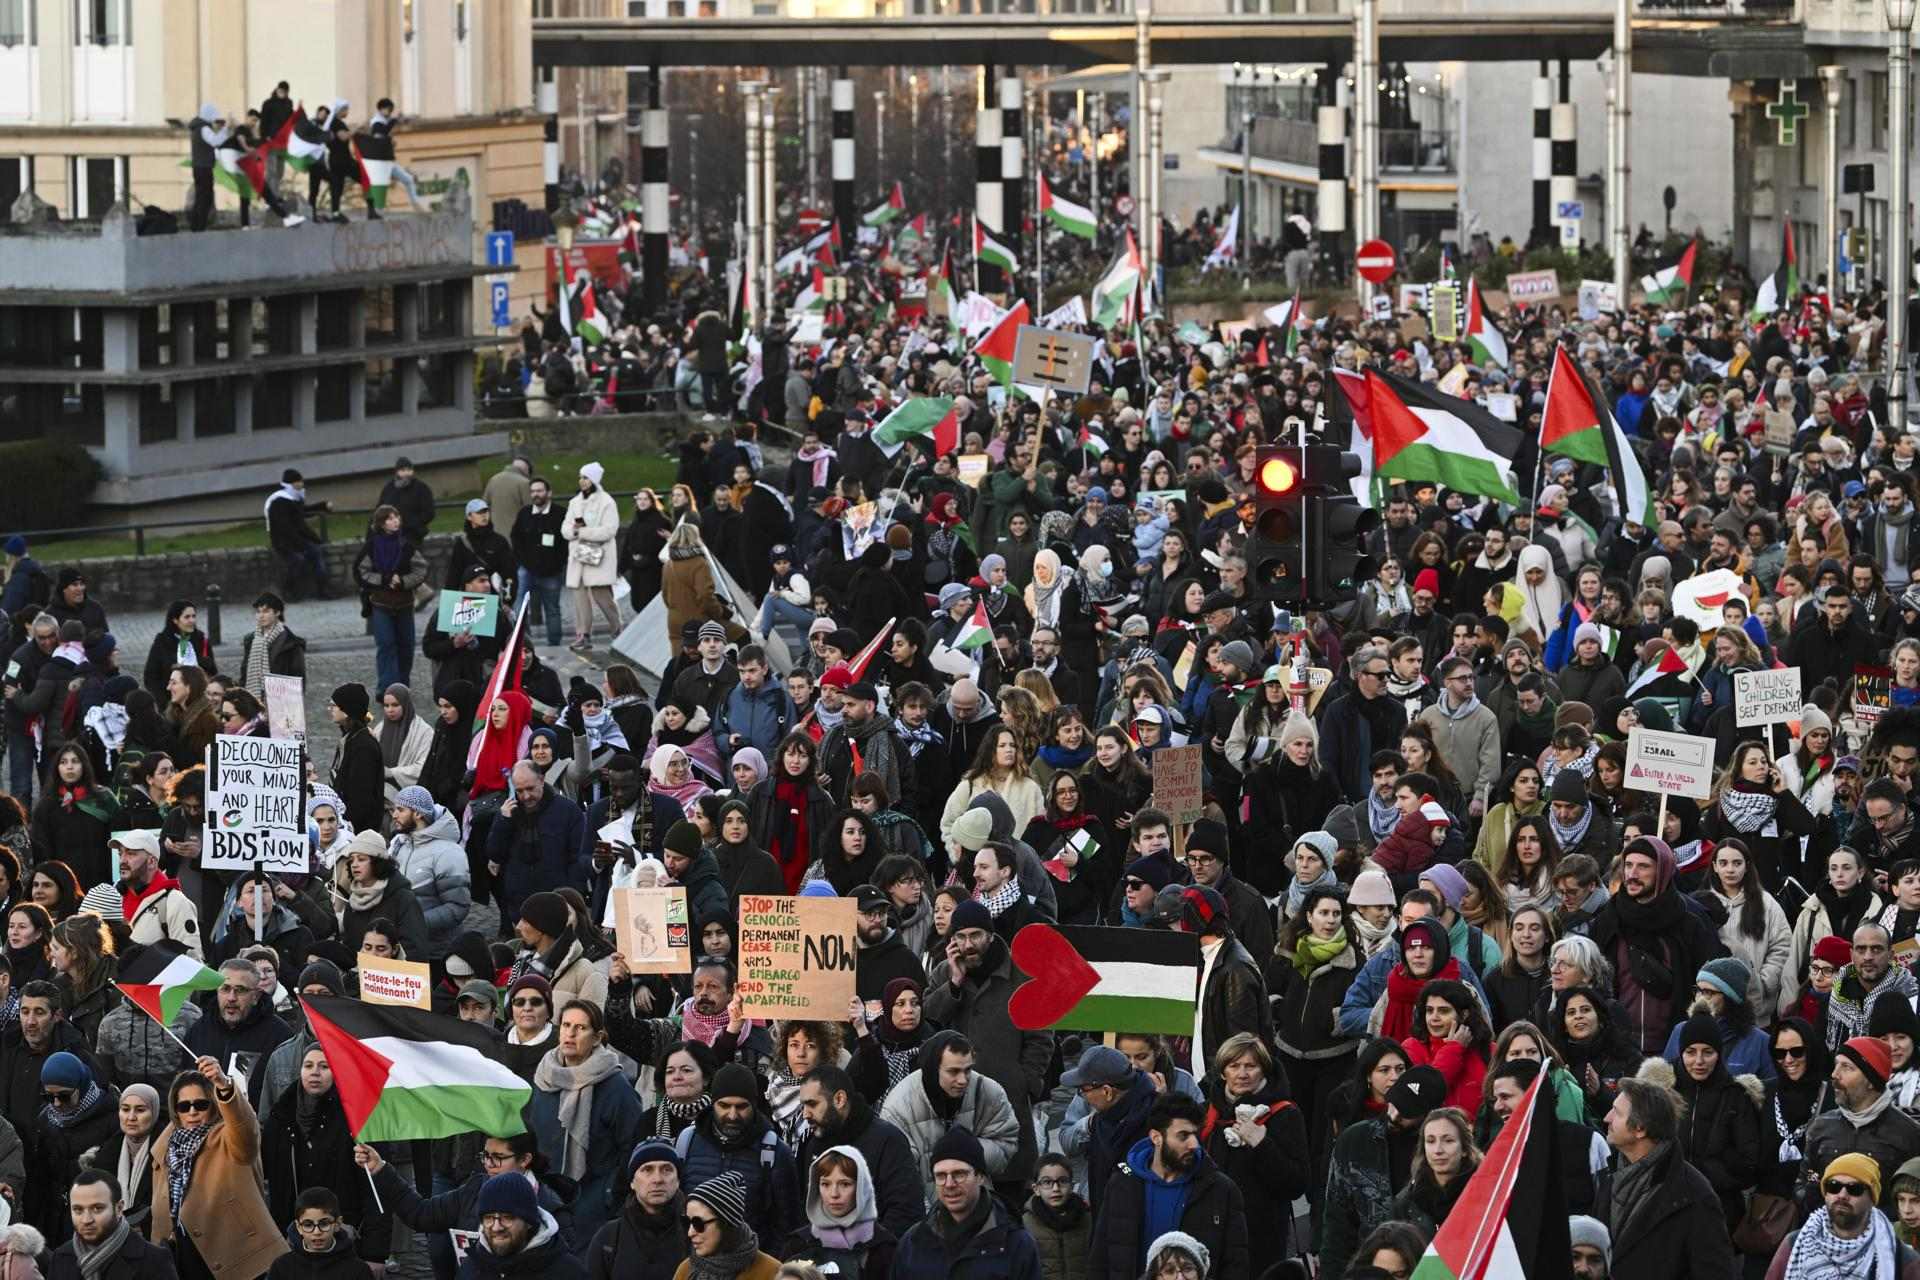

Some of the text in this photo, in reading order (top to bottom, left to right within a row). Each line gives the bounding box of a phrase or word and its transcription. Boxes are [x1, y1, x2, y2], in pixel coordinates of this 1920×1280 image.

[494, 286, 507, 311] P
[1737, 673, 1792, 693] IS KILLING
[1744, 687, 1793, 703] CHILDREN
[1738, 704, 1760, 719] SELF
[220, 740, 300, 765] DECOLONIZE
[1155, 750, 1179, 762] LAND
[1644, 746, 1676, 757] ISRAEL
[1184, 761, 1197, 774] TO
[222, 769, 255, 786] YOUR
[1155, 773, 1195, 788] COMMIT
[1666, 771, 1673, 780] A
[1658, 779, 1682, 791] STATE
[1155, 786, 1201, 800] GENOCIDE
[222, 793, 249, 809] AND
[211, 831, 304, 861] BDS NOW
[743, 897, 796, 913] STOP THE
[743, 914, 801, 927] GENOCIDE
[742, 929, 801, 942] PERMANENT
[741, 942, 801, 953] CEASE FIRE
[803, 934, 857, 971] NOW
[744, 956, 772, 967] ARMS
[363, 970, 421, 989] Cessez-le-feu
[749, 968, 801, 981] EMBARGO
[740, 982, 793, 993] END THE
[744, 994, 811, 1008] APARTHEID
